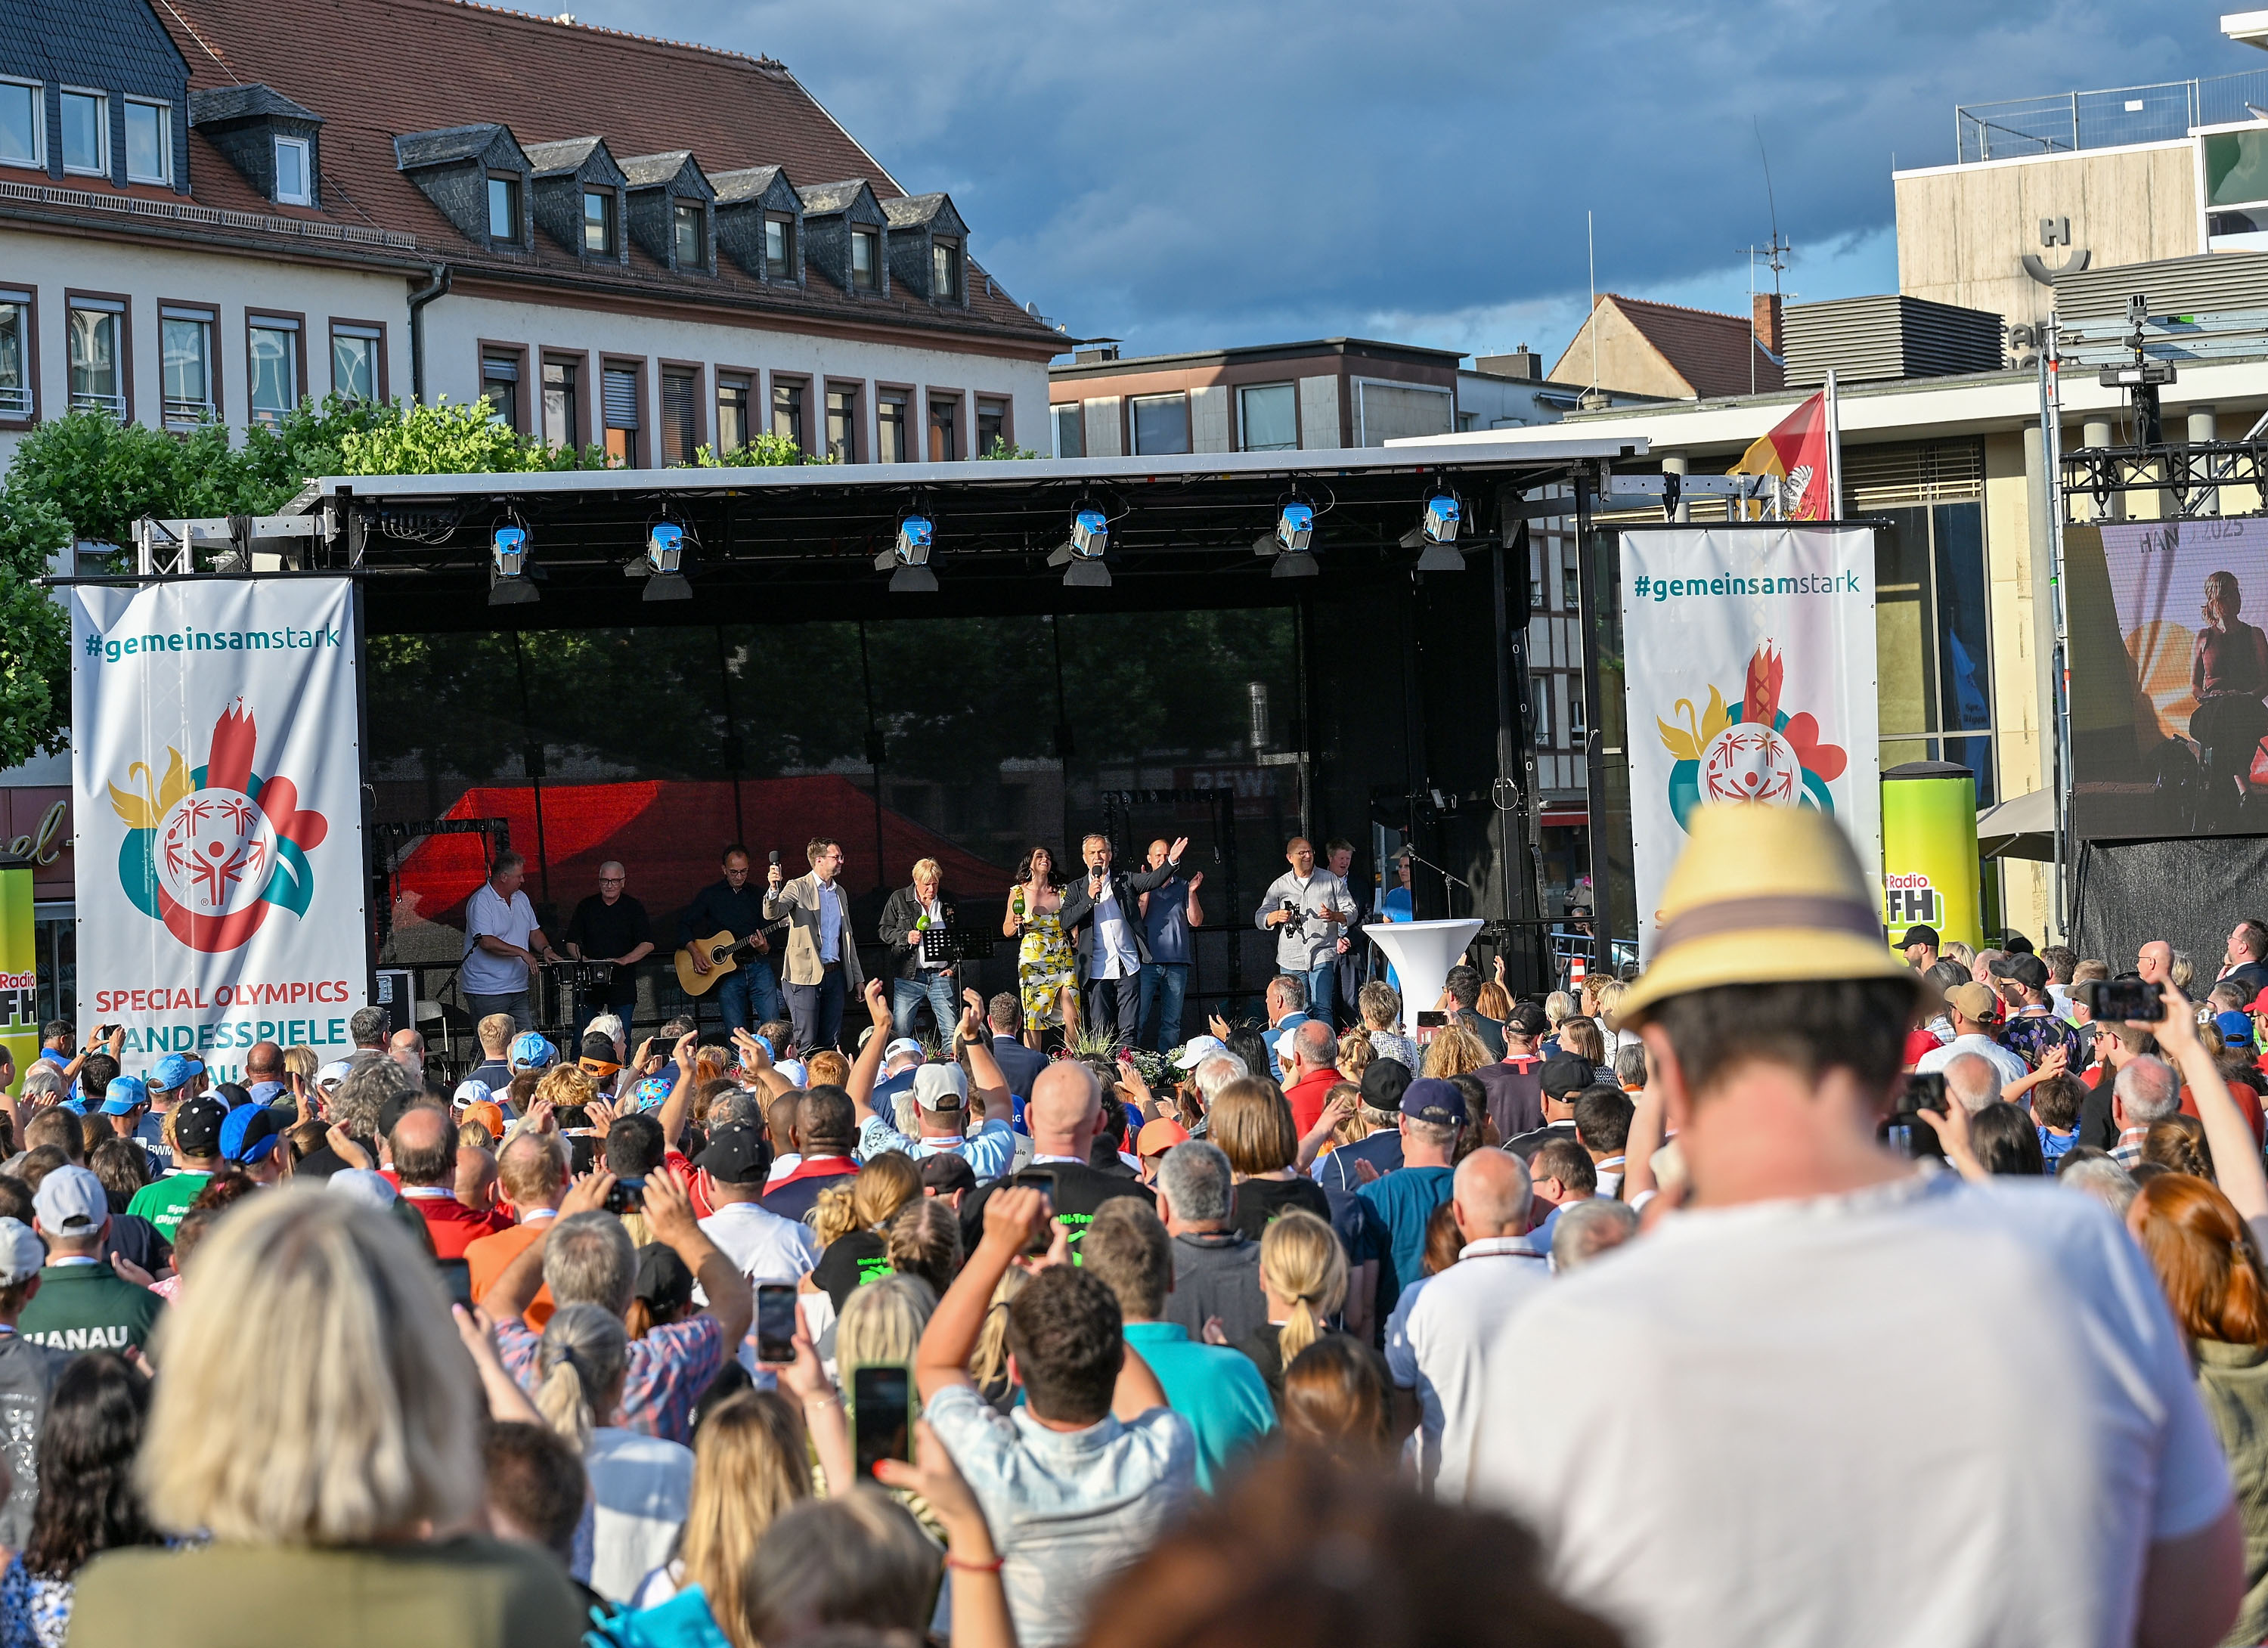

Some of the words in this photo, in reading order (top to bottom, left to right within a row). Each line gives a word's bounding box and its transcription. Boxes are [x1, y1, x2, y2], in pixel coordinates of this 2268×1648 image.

[1634, 568, 1861, 603] #gemeinsamstark
[85, 622, 340, 663] #gemeinsamstark
[1889, 874, 1928, 888] Radio
[0, 971, 35, 989] Radio
[95, 987, 209, 1013] SPECIAL
[214, 980, 350, 1007] OLYMPICS
[101, 1018, 348, 1054] ANDESSPIELE
